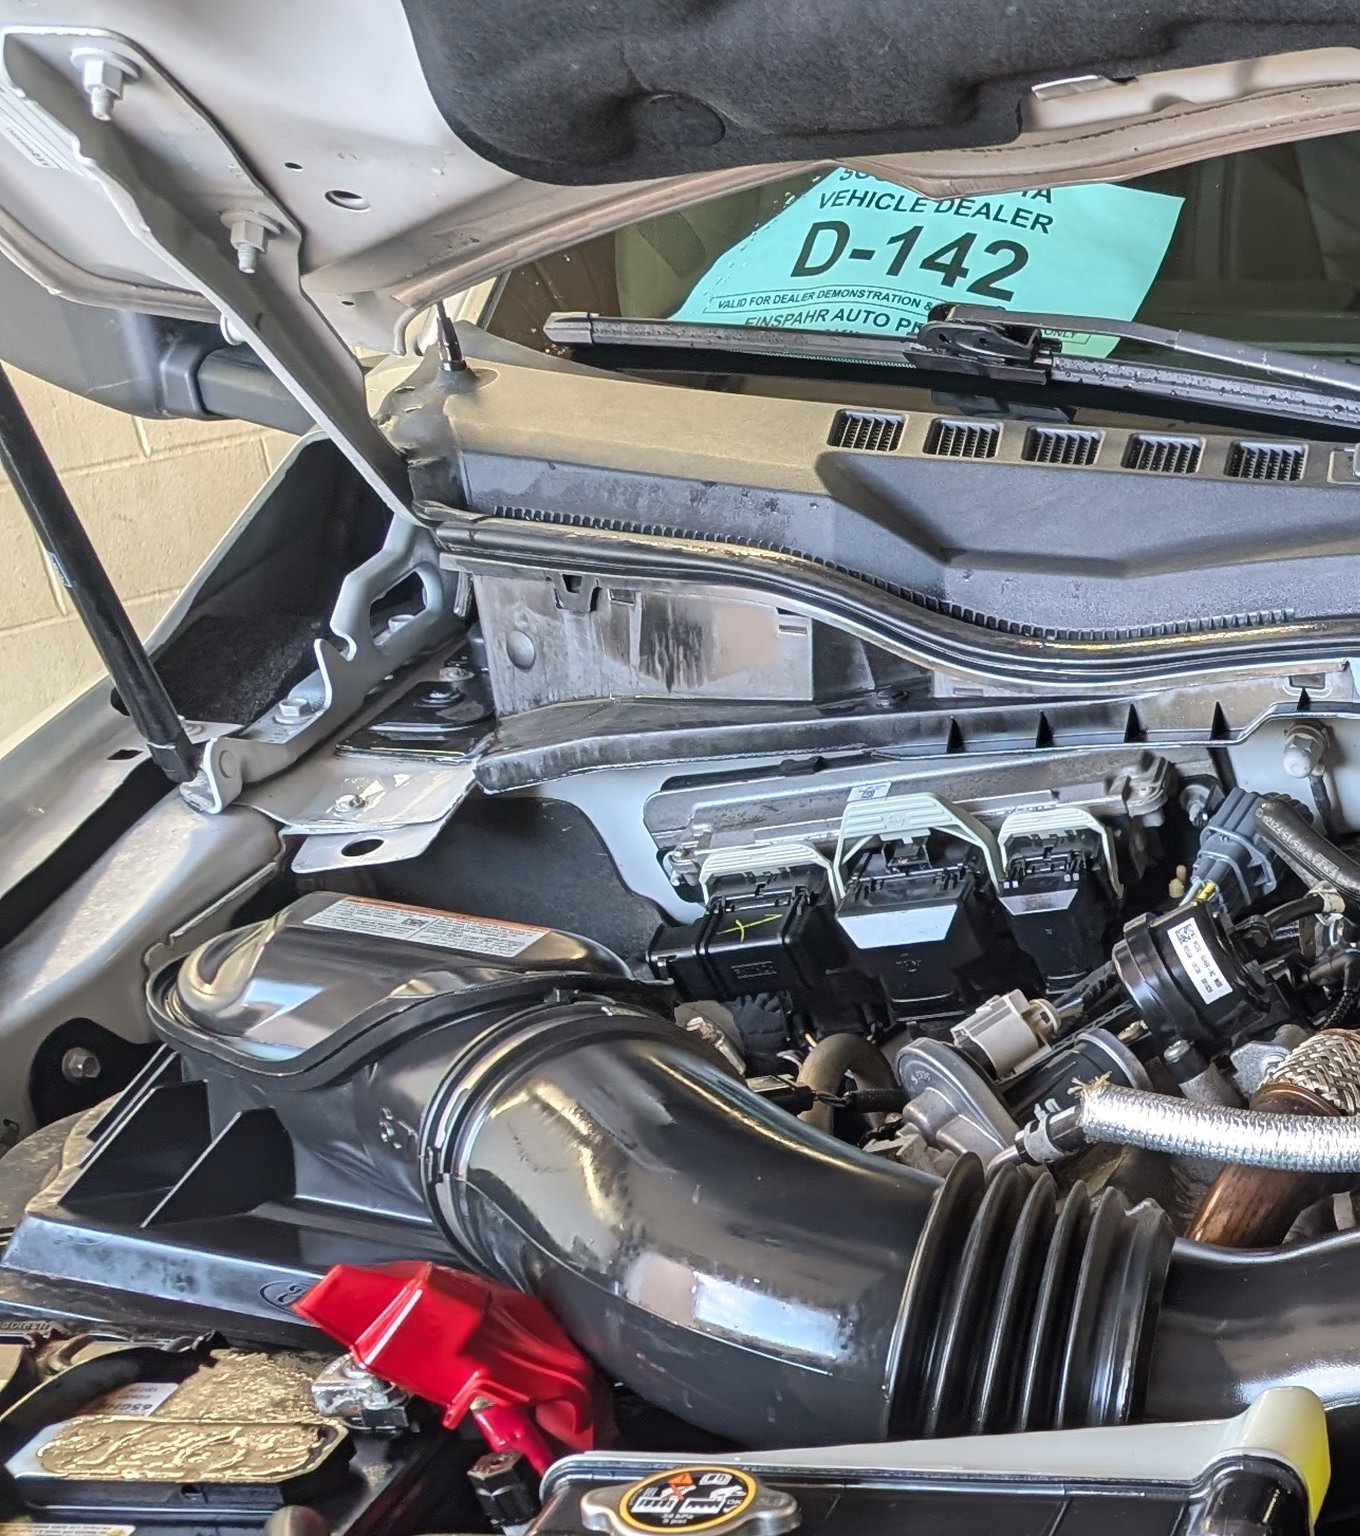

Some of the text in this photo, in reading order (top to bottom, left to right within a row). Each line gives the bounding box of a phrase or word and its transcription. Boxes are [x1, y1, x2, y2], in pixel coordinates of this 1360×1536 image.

[819, 189, 1054, 234] VEHICLE DEALER
[790, 220, 1029, 302] D-142
[718, 298, 747, 309] VALID
[749, 295, 771, 306] FOR
[773, 292, 815, 305] DEALER
[816, 289, 922, 308] DEMONSTRATION
[745, 309, 830, 327] EINSPAHR
[831, 308, 891, 328] AUTO
